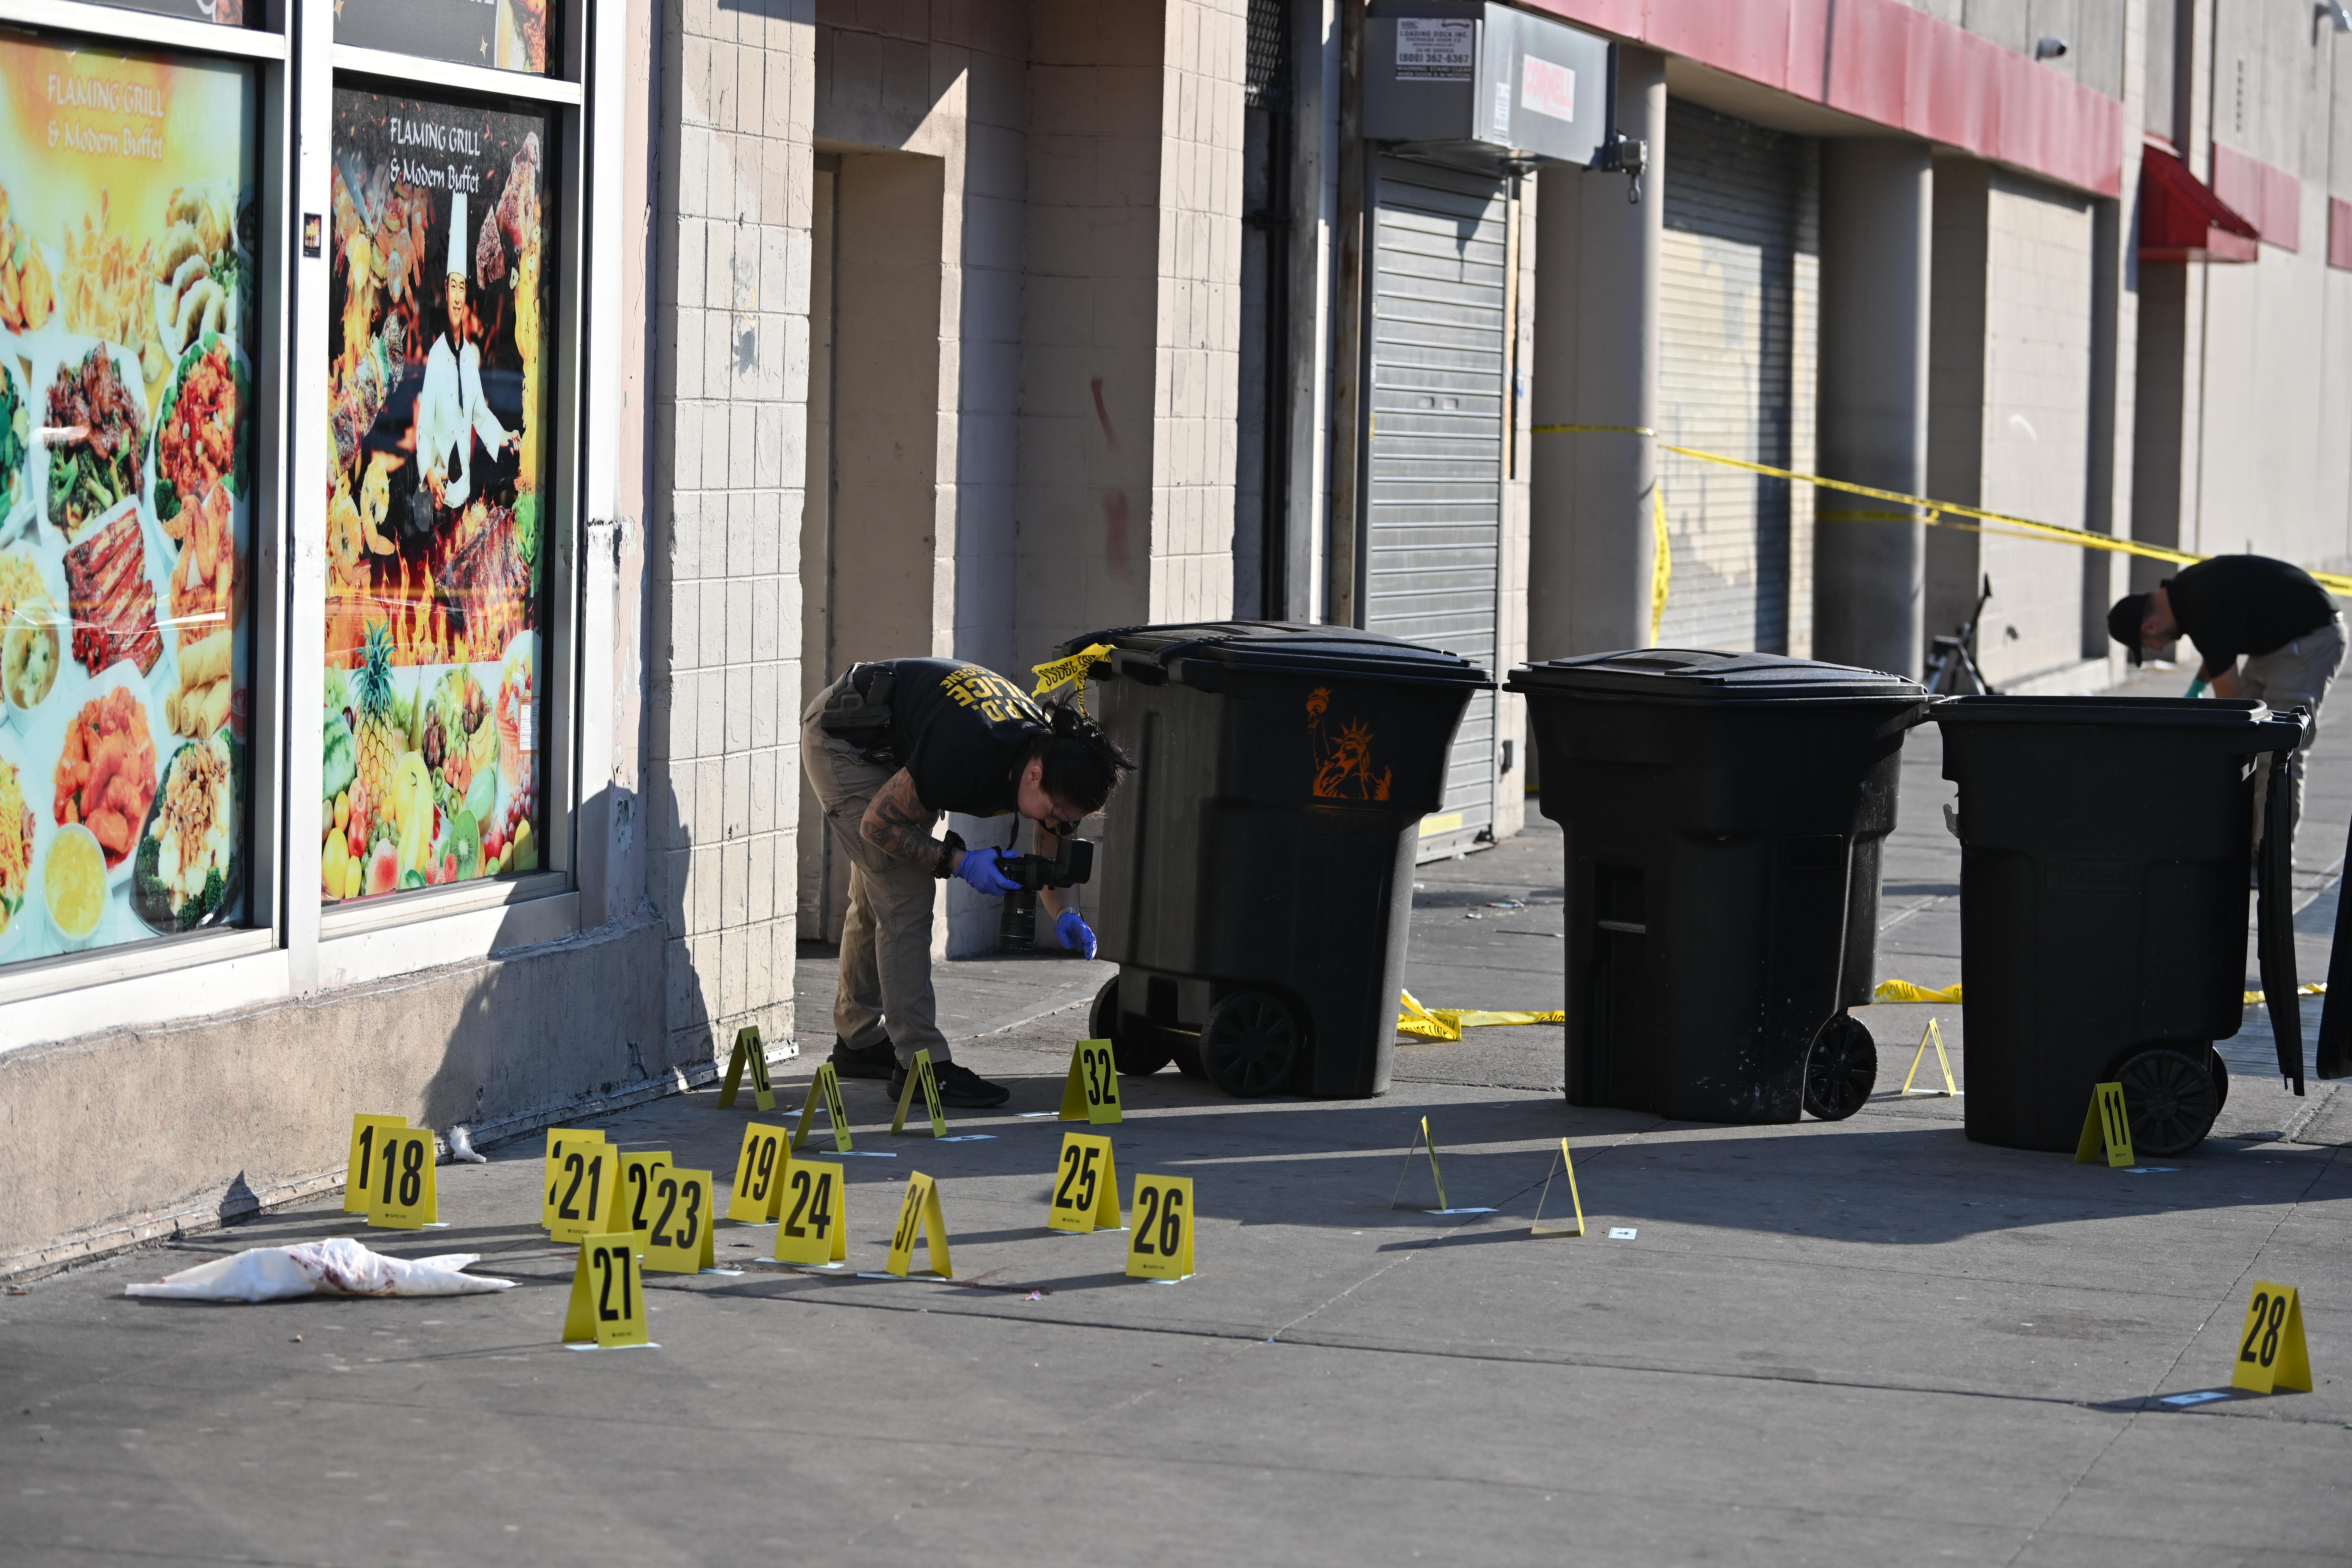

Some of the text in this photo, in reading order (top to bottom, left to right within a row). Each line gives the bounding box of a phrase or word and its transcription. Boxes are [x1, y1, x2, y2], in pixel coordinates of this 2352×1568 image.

[1399, 53, 1423, 62] (800)
[1525, 59, 1573, 110] CORNELL
[48, 74, 164, 117] FLAMING GRILL
[48, 120, 163, 160] & Modern Buffet
[390, 118, 481, 156] FLAMING GRILL
[390, 158, 479, 193] & Modern Buffet
[940, 668, 986, 689] SCENE
[1038, 661, 1078, 686] CROSS
[747, 1036, 769, 1092] 12
[922, 1061, 941, 1119] 13
[1084, 1048, 1116, 1106] 32
[824, 1070, 845, 1130] 14
[2105, 1091, 2126, 1146] 11
[383, 1139, 424, 1206] 18
[558, 1153, 602, 1221] 21
[741, 1136, 776, 1201] 19
[1056, 1145, 1100, 1211] 25
[650, 1179, 700, 1249] 23
[784, 1170, 831, 1239] 24
[895, 1184, 925, 1253] 31
[1134, 1187, 1182, 1257] 26
[594, 1247, 631, 1321] 27
[2240, 1293, 2286, 1367] 28
